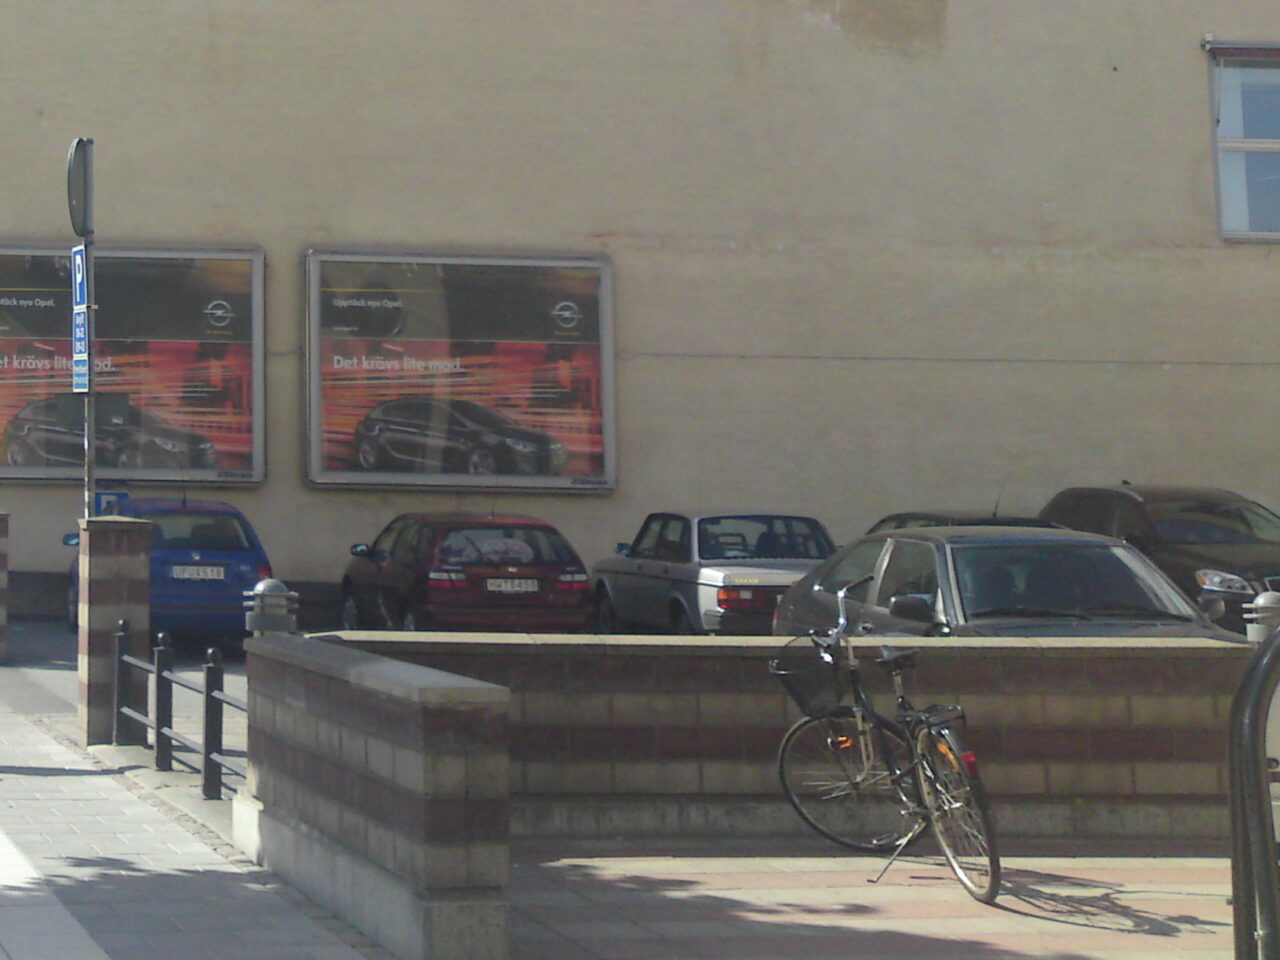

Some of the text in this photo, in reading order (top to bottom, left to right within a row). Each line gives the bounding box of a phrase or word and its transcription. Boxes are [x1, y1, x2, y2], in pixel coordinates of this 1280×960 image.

[75, 254, 83, 302] P
[12, 354, 51, 370] krävs
[333, 355, 358, 369] Det
[362, 354, 400, 370] krävs
[403, 355, 425, 370] lite
